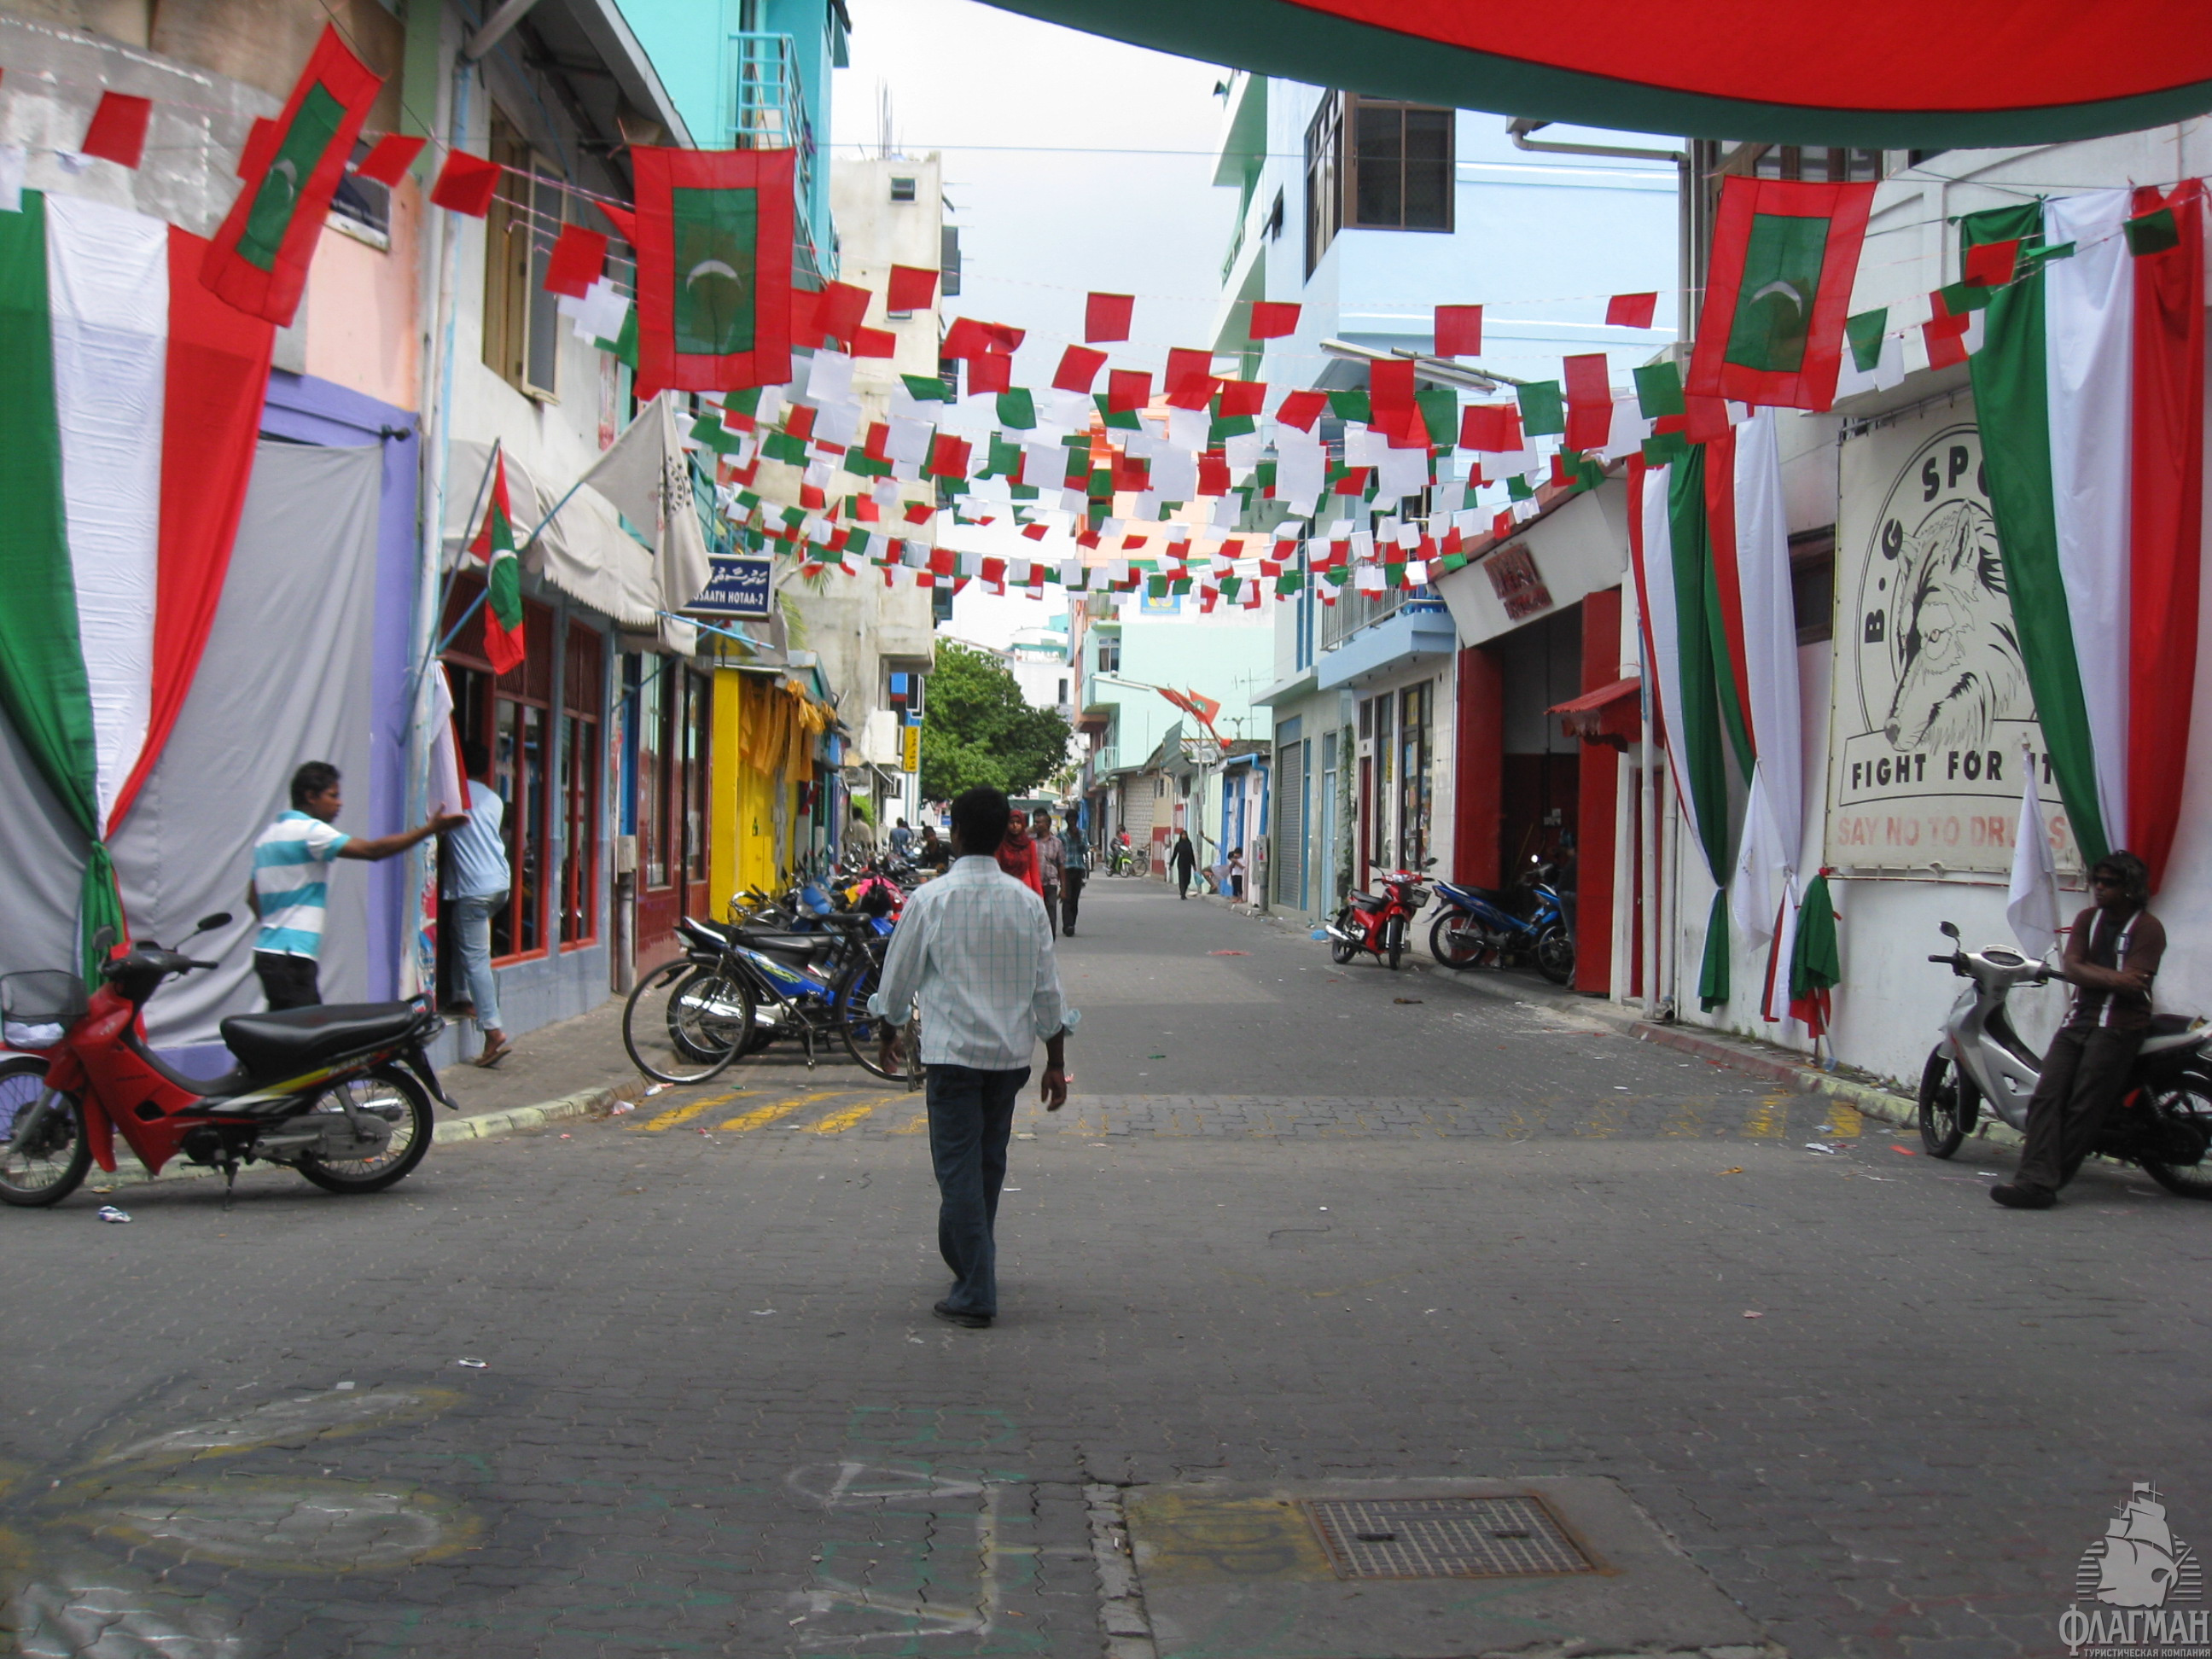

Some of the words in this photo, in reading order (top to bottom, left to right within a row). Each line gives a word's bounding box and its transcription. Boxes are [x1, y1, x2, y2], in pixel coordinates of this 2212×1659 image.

[728, 591, 764, 606] HOTAA-2
[1852, 753, 1926, 790] FIGHT
[1947, 750, 2002, 781] FOR
[1837, 817, 1877, 846] SAY
[1886, 817, 1920, 847] NO
[1927, 816, 1960, 847] TO
